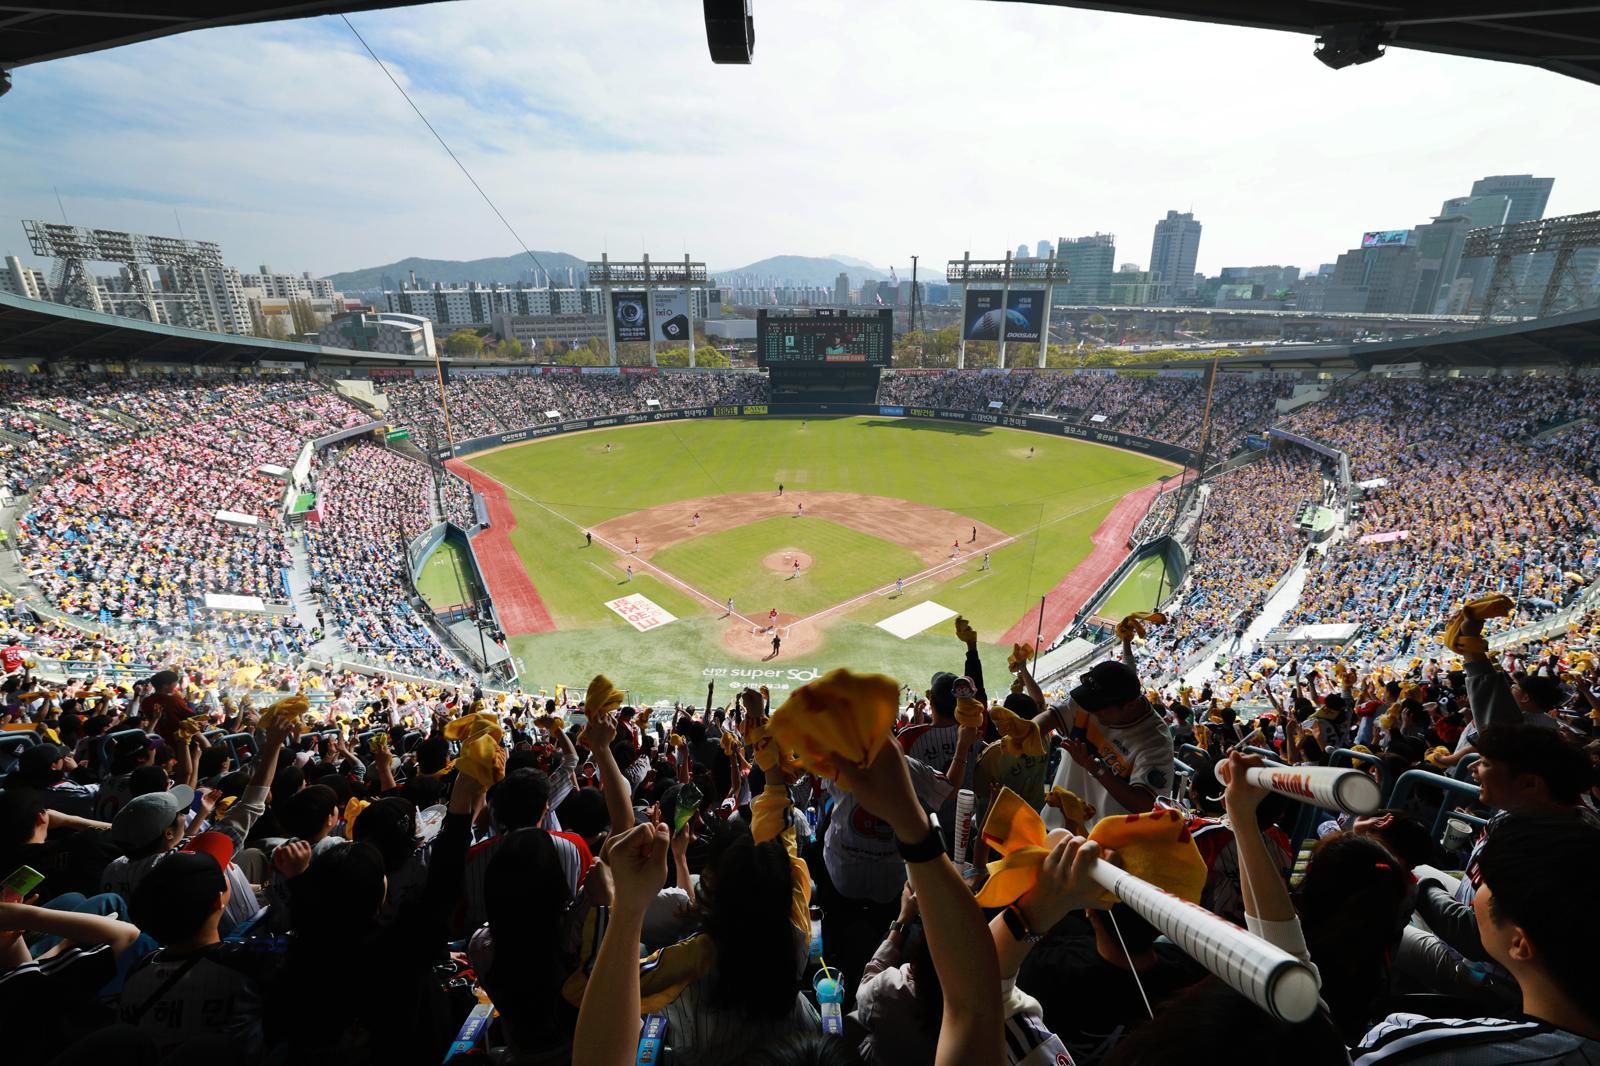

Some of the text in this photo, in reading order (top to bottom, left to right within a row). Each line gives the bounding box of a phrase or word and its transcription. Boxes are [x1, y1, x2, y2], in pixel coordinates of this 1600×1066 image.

[683, 408, 707, 417] 현대해상
[910, 408, 935, 417] 대방건설
[702, 667, 823, 682] 신한 super SOL
[1271, 772, 1316, 799] TWINS
[960, 811, 974, 849] TWINS
